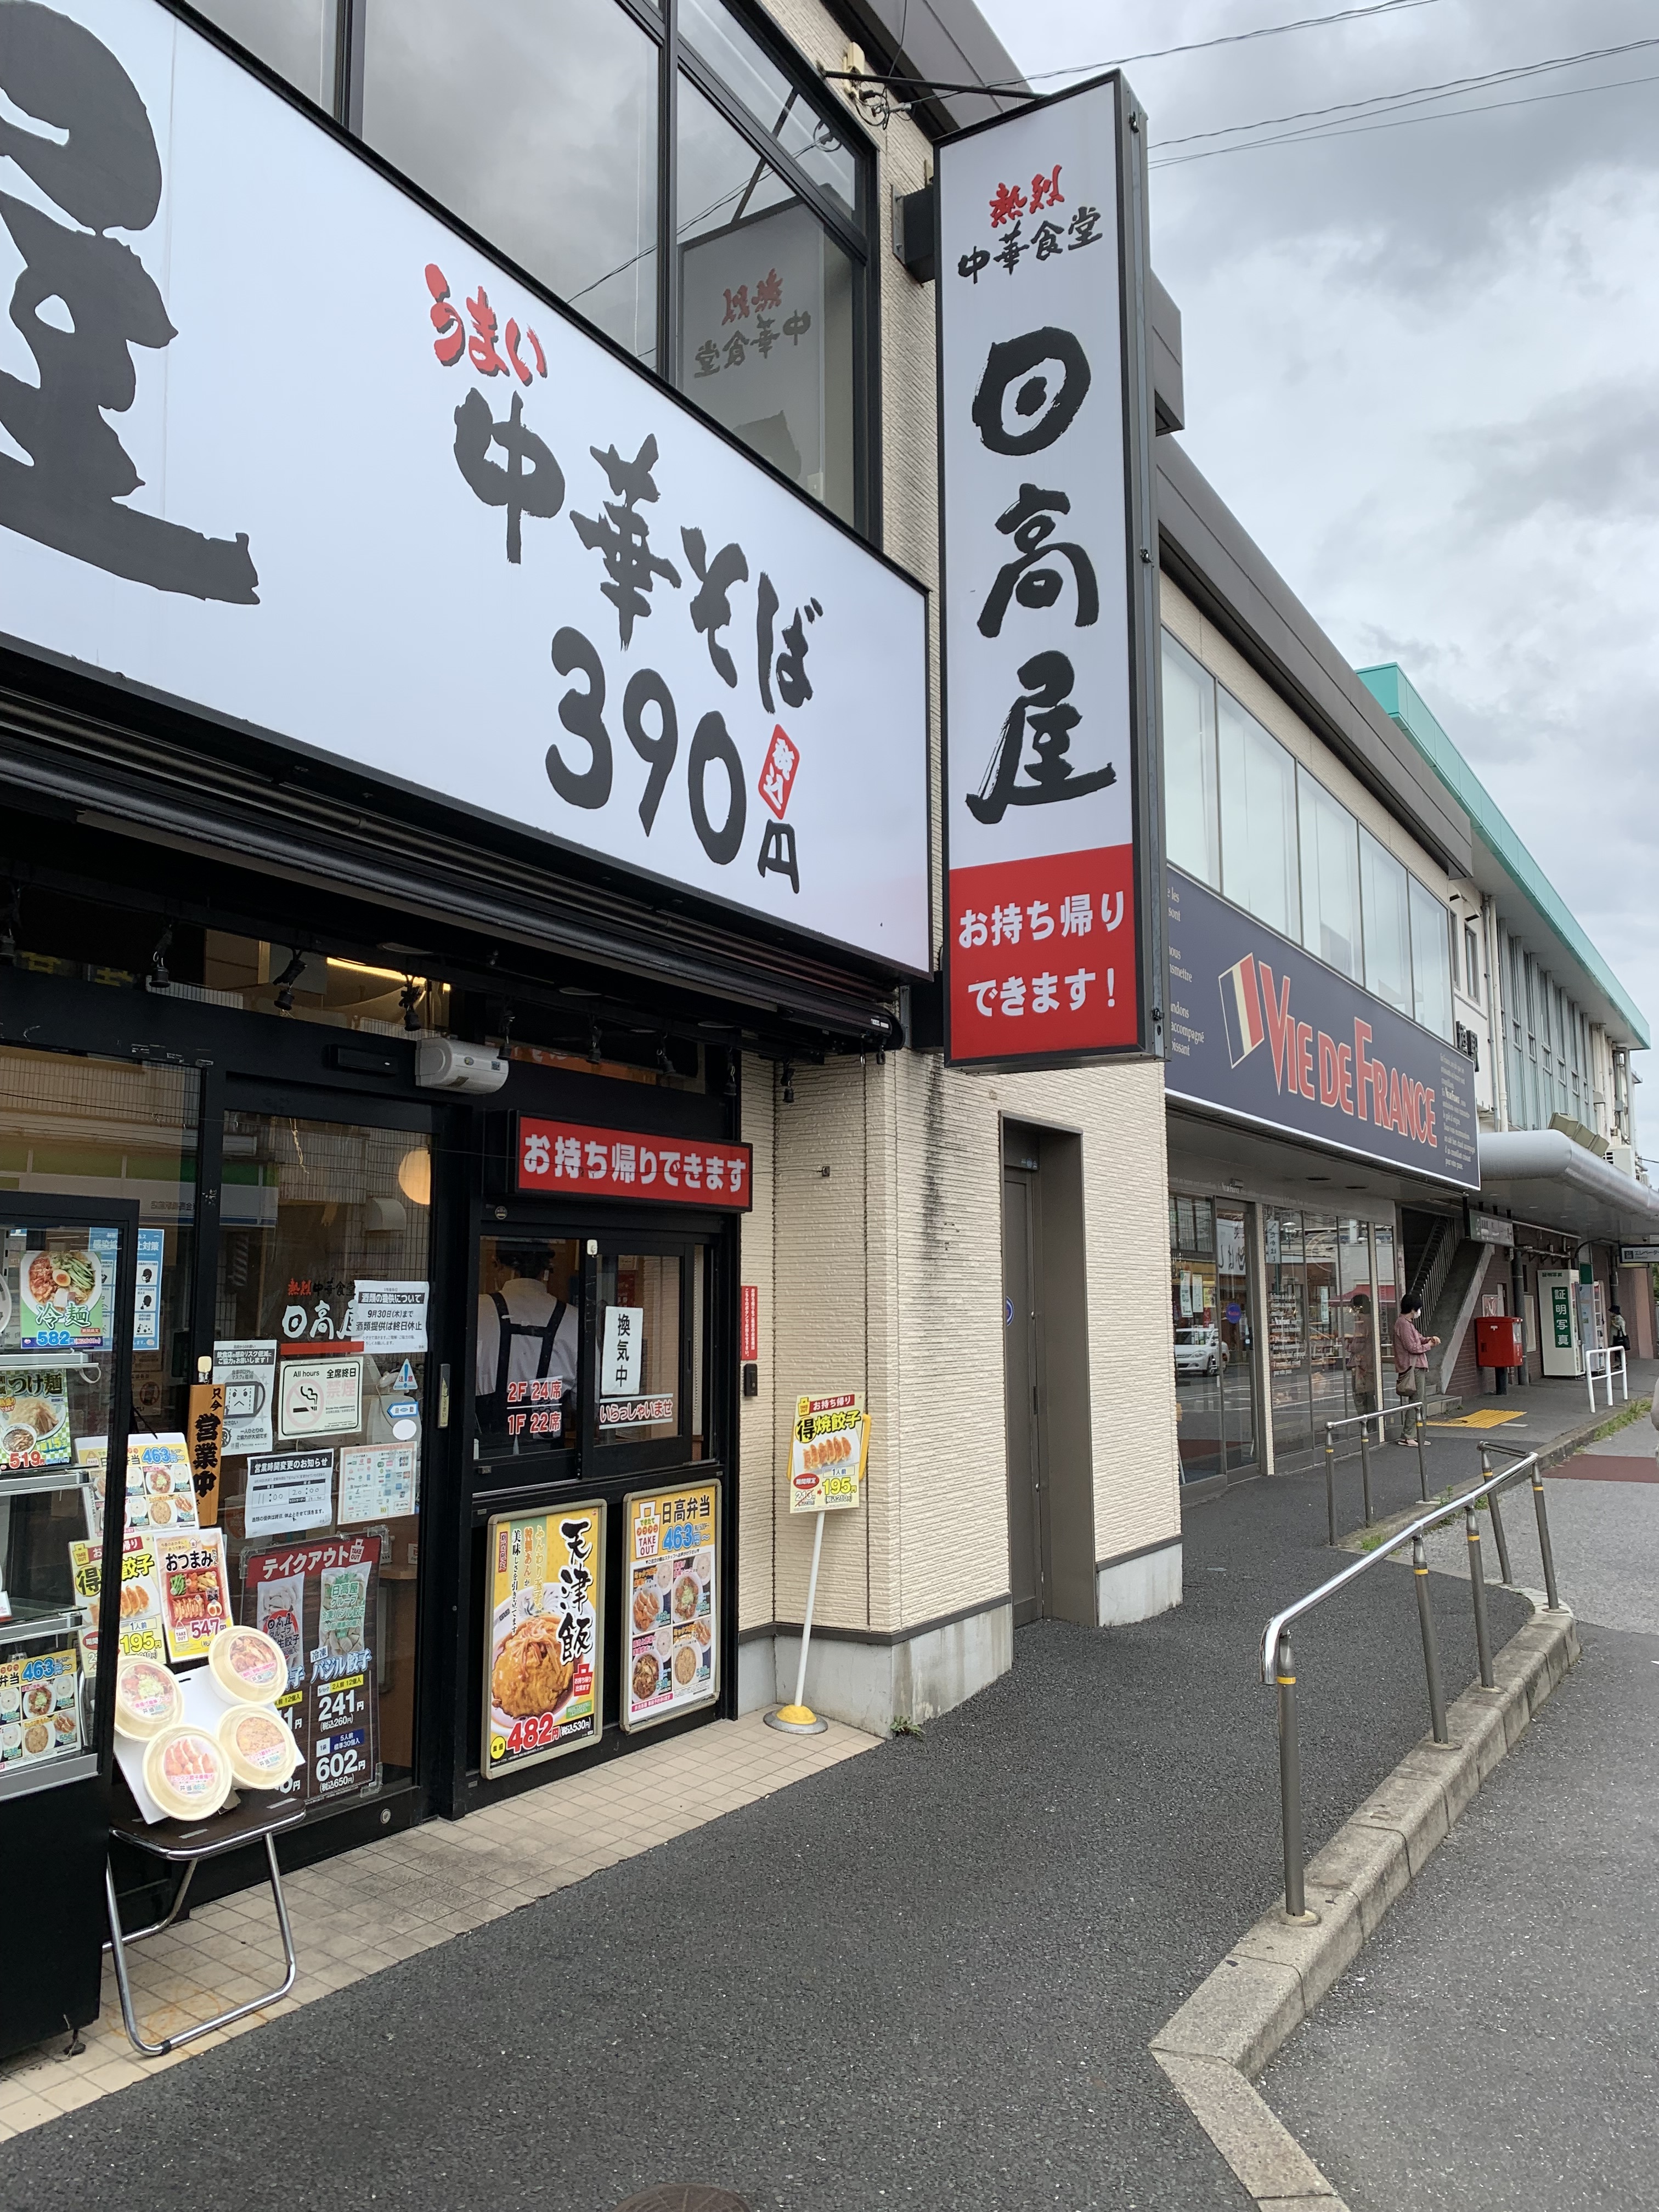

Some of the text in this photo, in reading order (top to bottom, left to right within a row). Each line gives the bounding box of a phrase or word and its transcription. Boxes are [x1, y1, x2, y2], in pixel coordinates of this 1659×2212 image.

[989, 165, 1065, 228] 熱烈
[958, 206, 1103, 284] 中華食堂
[424, 263, 548, 386] うまい
[453, 387, 824, 714] 中華そば
[964, 326, 1118, 825] 日高屋
[1171, 888, 1180, 903] les
[958, 890, 1126, 950] お持ち帰り
[1168, 908, 1181, 922] sont
[967, 968, 1116, 1017] できます！
[1259, 960, 1316, 1102] VIE
[1318, 1030, 1353, 1116] DE
[1354, 1016, 1437, 1148] FRANCE
[523, 1133, 746, 1193] お持ち帰りできます
[362, 1293, 422, 1303] 酒類の提供について
[35, 1302, 91, 1329] 冷麺
[368, 1310, 414, 1318] 9月30日(木)まで
[1554, 1289, 1568, 1346] 証明写真
[356, 1322, 422, 1331] 酒類提供は終日休止
[616, 1313, 630, 1388] 換気中
[326, 1368, 357, 1379] 全席終日
[210, 1387, 223, 1411] 只今
[326, 1379, 356, 1397] 禁煙
[507, 1379, 562, 1402] 2F 24席
[599, 1399, 673, 1424] いらっしゃいませ
[813, 1396, 850, 1411] お持ち帰り
[507, 1412, 561, 1435] 1F 22席
[193, 1413, 221, 1498] 営業中
[254, 1457, 328, 1474] 営業時間変更のお知らせ
[822, 1477, 856, 1495] 195円
[662, 1494, 710, 1525] 日高弁当
[639, 1536, 656, 1547] TAKE
[640, 1545, 654, 1556] OUT
[165, 1550, 213, 1571] おつまみ
[263, 1547, 349, 1580] テイクアウト
[332, 1582, 358, 1596] 日高屋
[511, 1529, 521, 1636] 美味しさを引き立てます
[558, 1521, 591, 1662] 天津飯
[330, 1595, 357, 1607] グループ
[267, 1612, 292, 1629] 日高屋
[321, 1605, 365, 1622] 冷凍バジル餃子
[130, 1621, 147, 1630] 1人前
[120, 1631, 162, 1654] 195円
[274, 1634, 300, 1649] 生餃子
[312, 1648, 327, 1660] 冷凍
[310, 1648, 371, 1685] バジル餃子
[332, 1677, 362, 1690] 2人前 12個入
[284, 1694, 301, 1703] 12個入
[318, 1689, 364, 1722] 241円
[320, 1713, 353, 1732] (税込260円)
[506, 1712, 591, 1754] 482円 (税込530円)
[334, 1739, 360, 1751] 標準30個入
[340, 1733, 353, 1741] 5人前
[315, 1748, 365, 1782] 602円
[319, 1773, 354, 1793] (税込650円)
